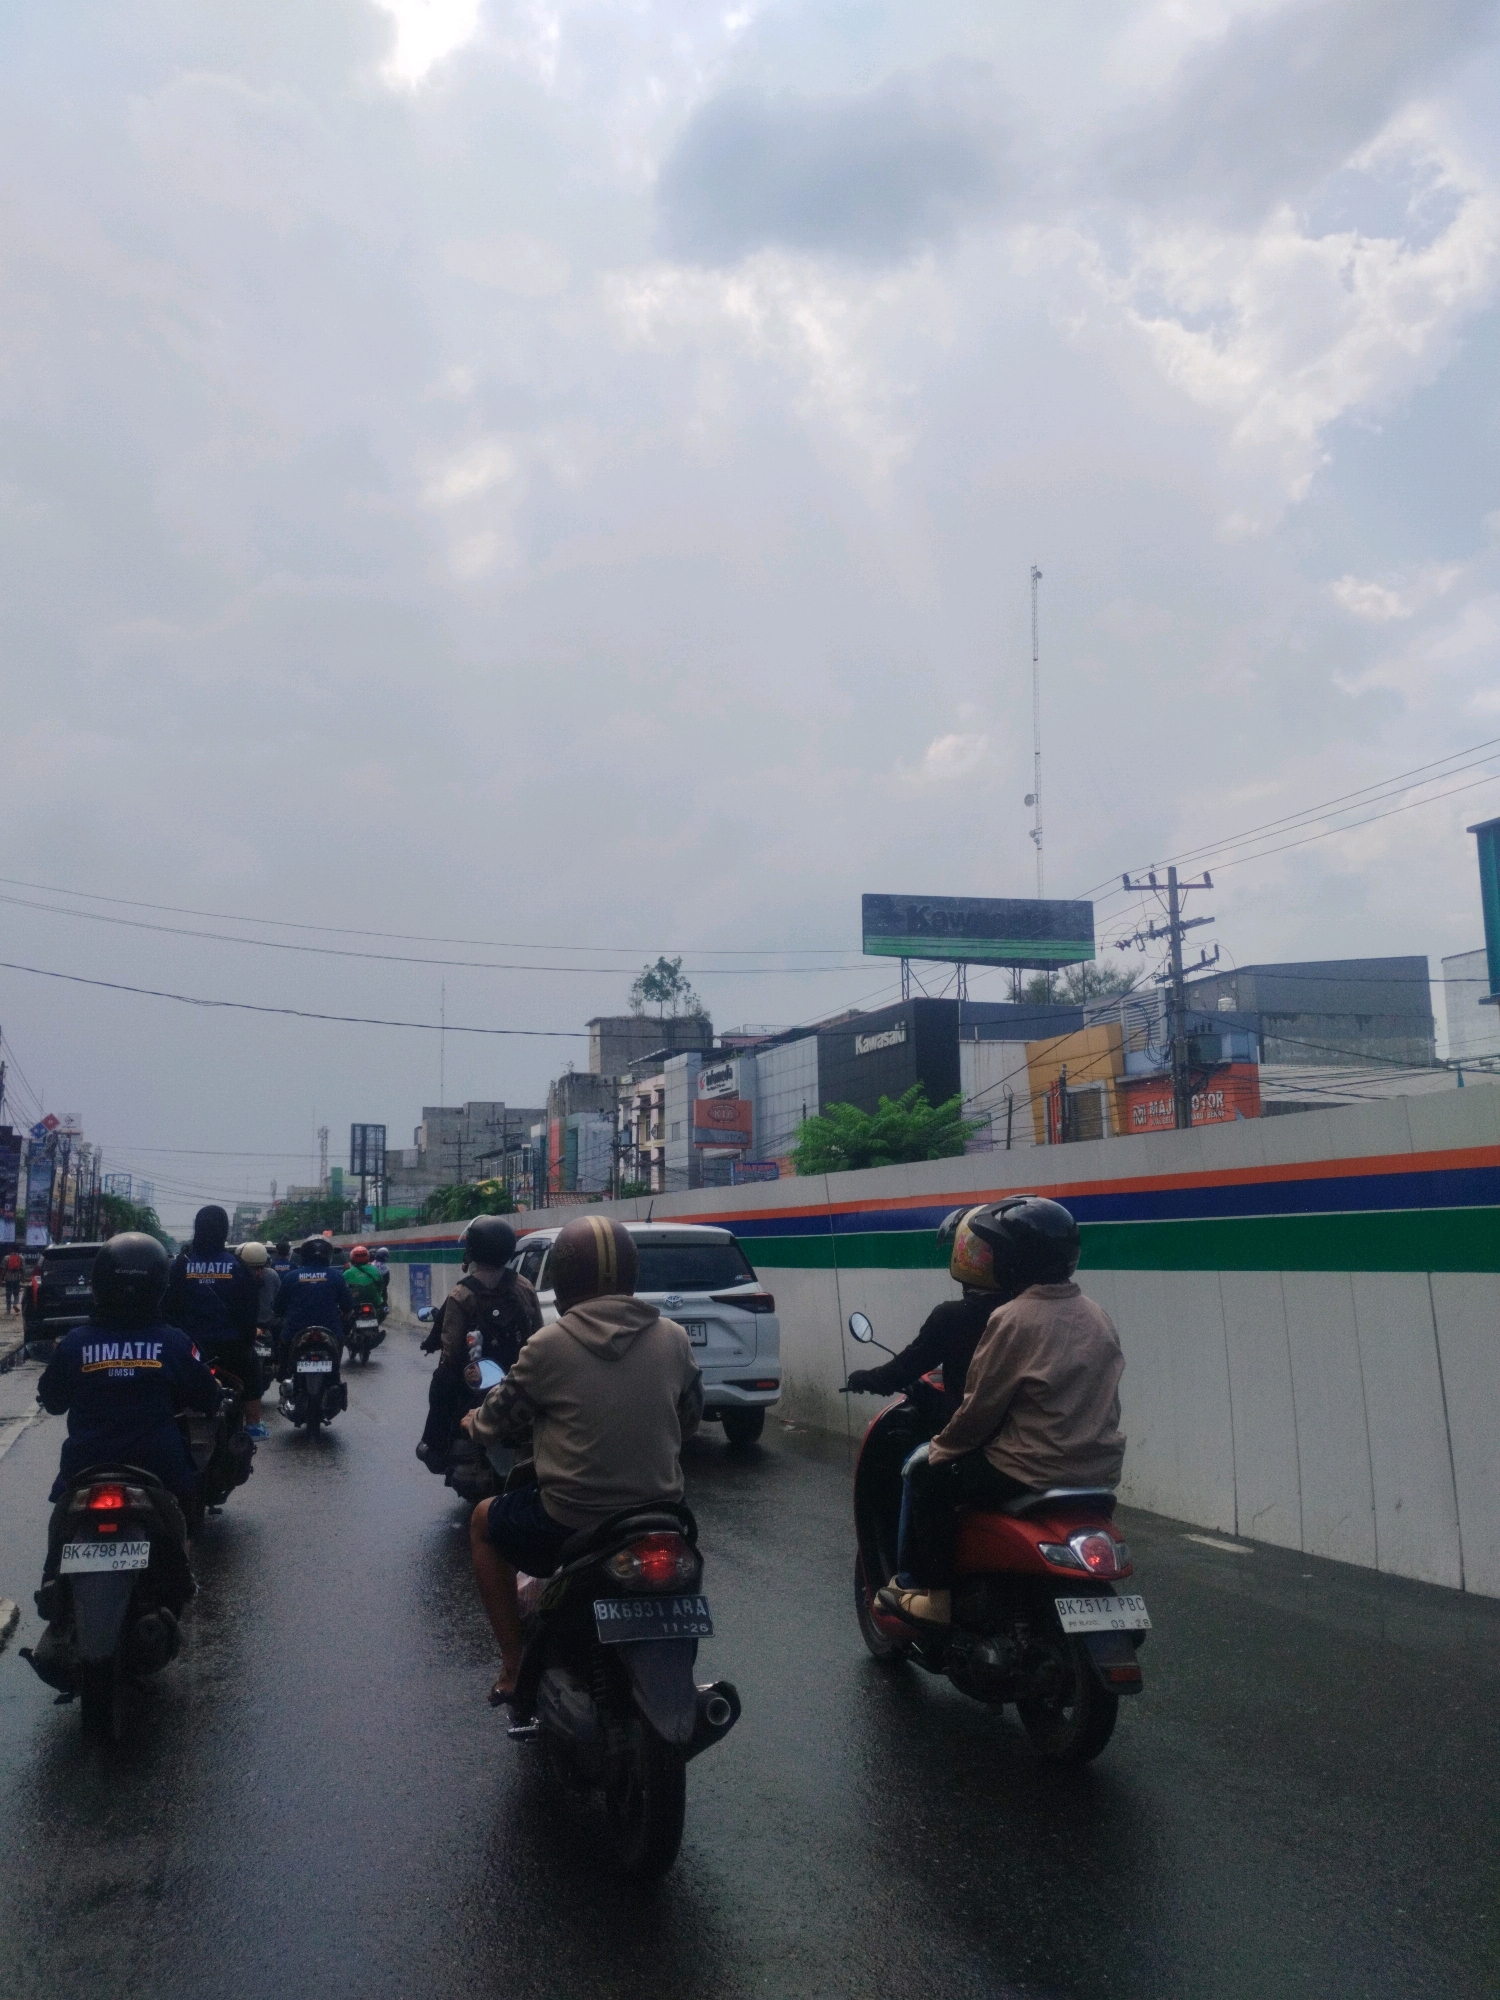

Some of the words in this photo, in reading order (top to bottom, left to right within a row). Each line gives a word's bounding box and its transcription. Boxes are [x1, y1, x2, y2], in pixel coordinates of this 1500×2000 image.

[855, 1020, 906, 1056] Kawasaki
[82, 1341, 163, 1365] HIMATIF
[108, 1368, 135, 1377] UMSU
[120, 1542, 149, 1556] AMC
[1119, 1597, 1145, 1612] PBC
